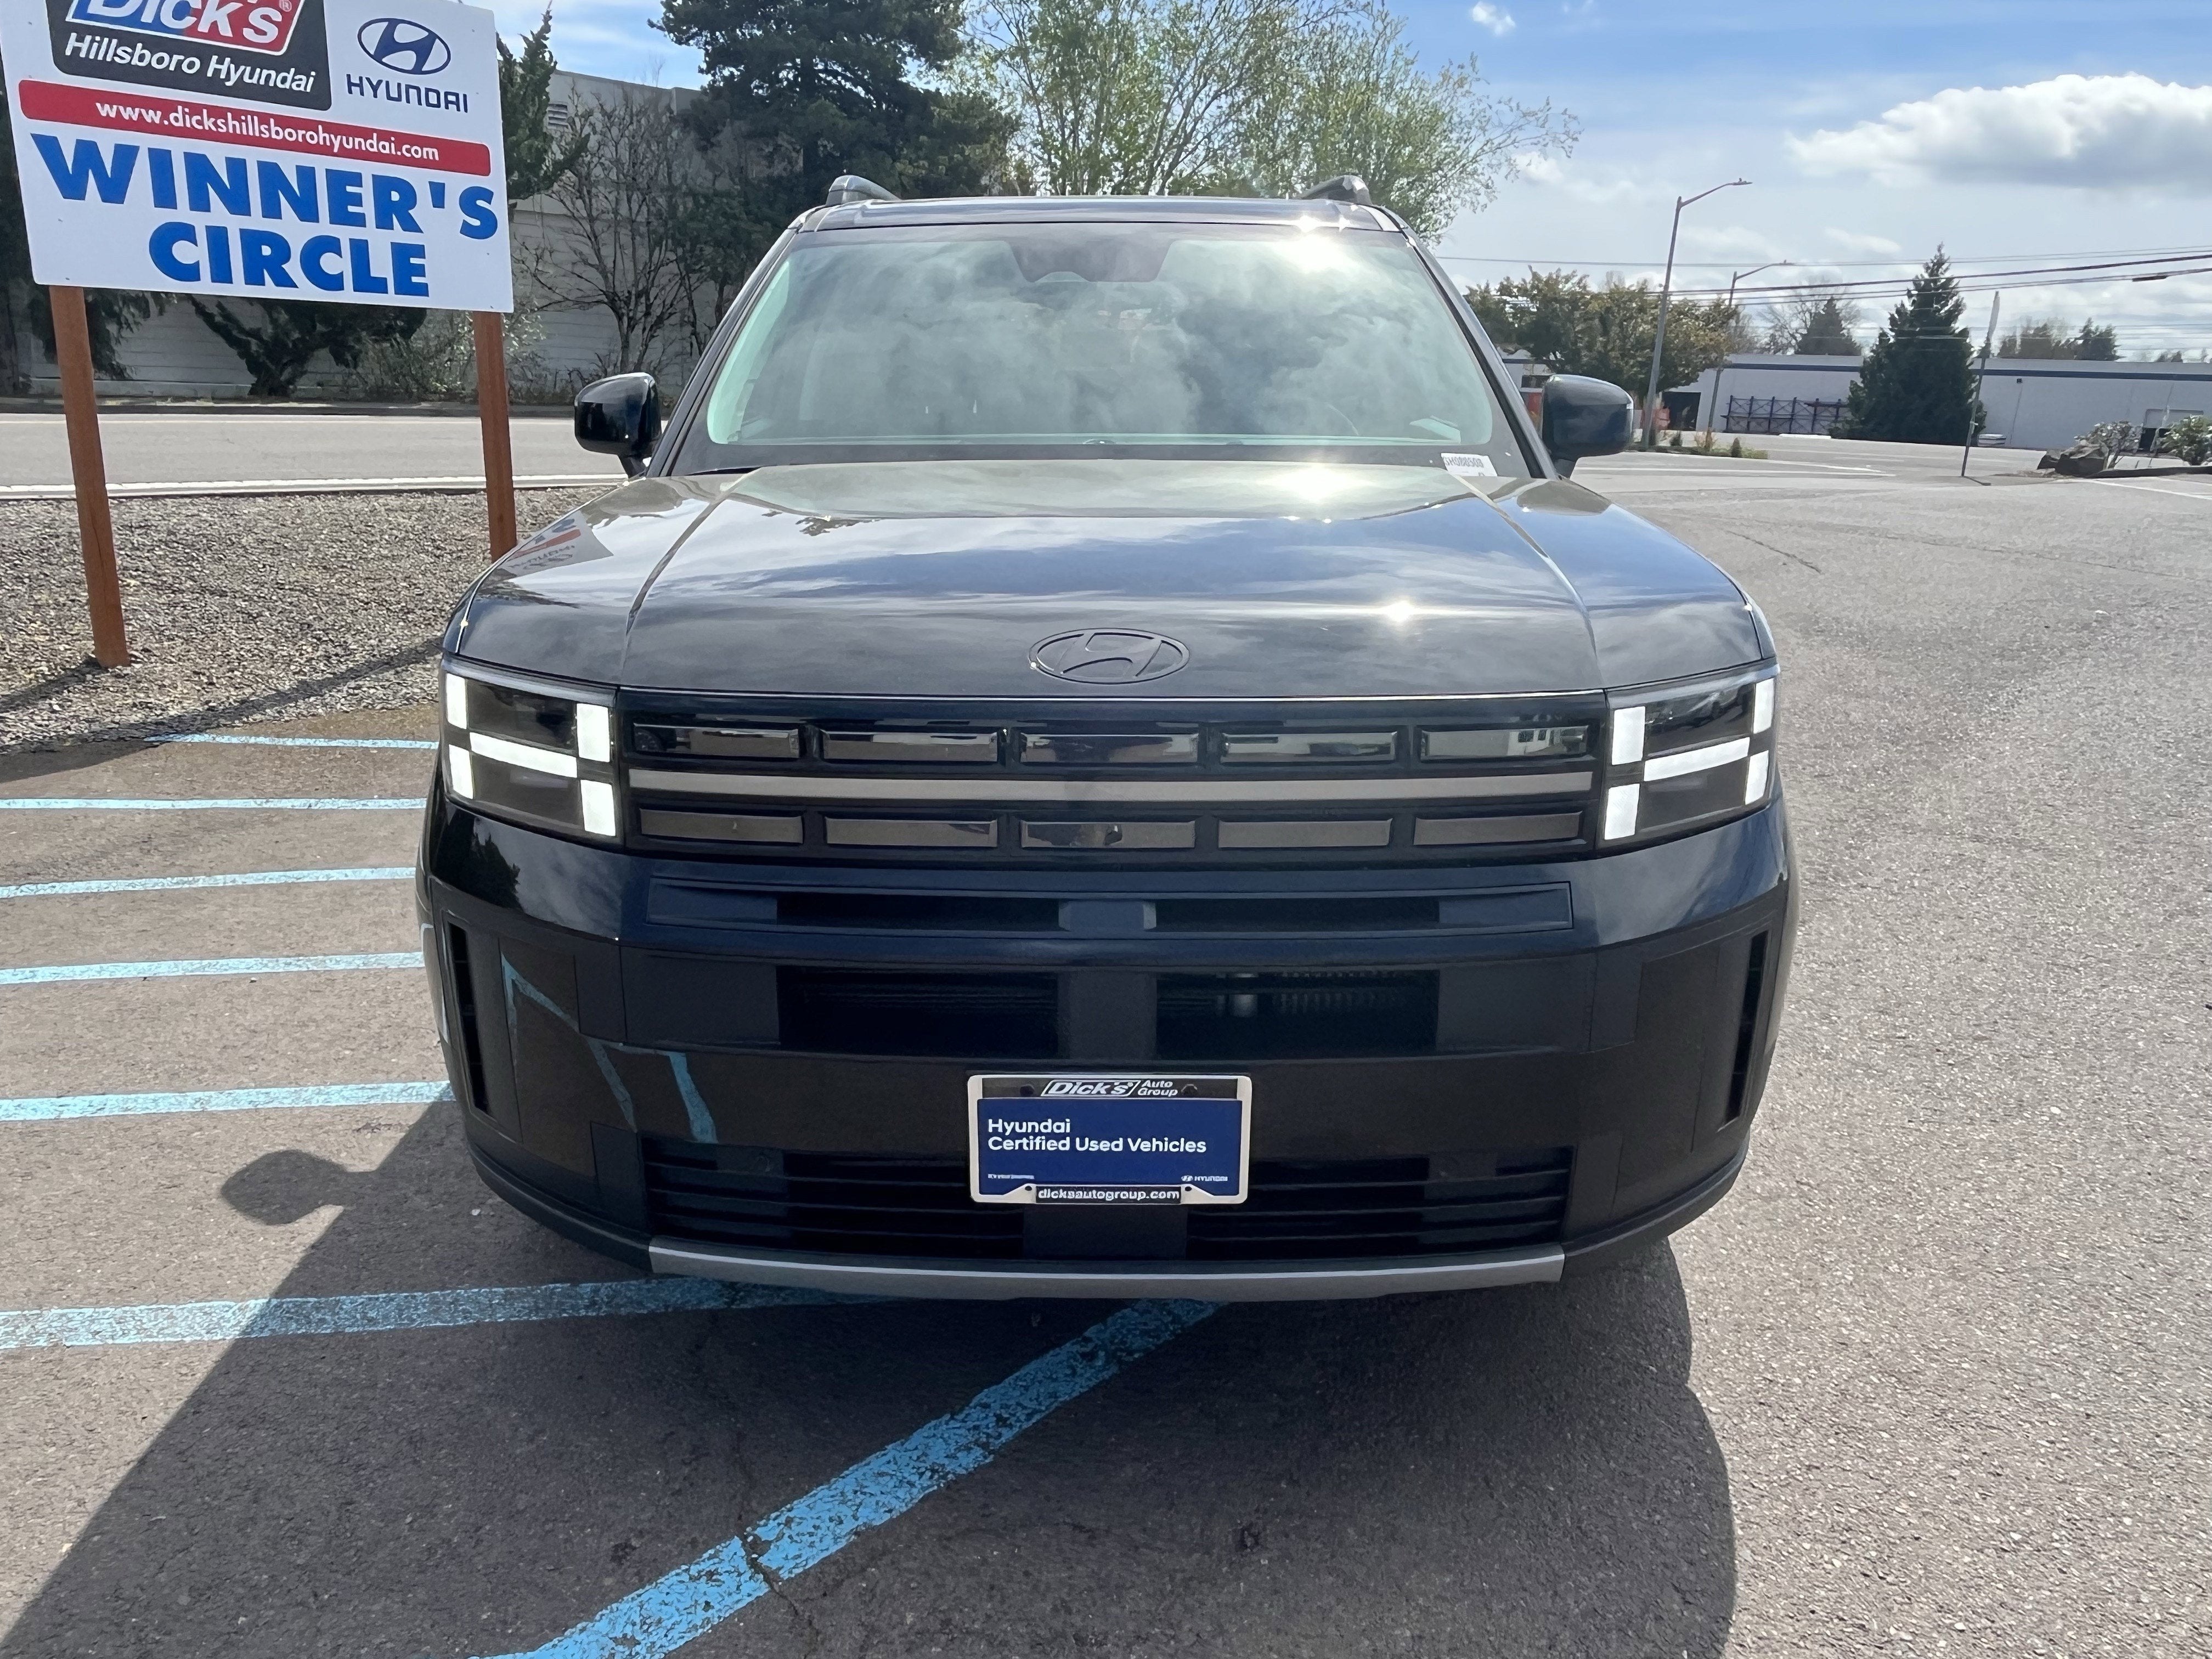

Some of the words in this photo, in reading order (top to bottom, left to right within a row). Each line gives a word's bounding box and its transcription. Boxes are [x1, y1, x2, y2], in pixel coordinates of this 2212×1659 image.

[65, 33, 200, 74] Hillsboro
[207, 55, 316, 92] Hyundai
[346, 74, 468, 113] HYUNDAI
[95, 100, 439, 161] www.dickshillsborohyundai.com
[31, 133, 498, 240] WINNER'S
[149, 222, 430, 297] CIRCLE
[1048, 1082, 1128, 1095] Dick's
[1137, 1088, 1178, 1097] Group
[988, 1119, 1071, 1135] Hyundai
[988, 1136, 1071, 1151] Certified
[1075, 1138, 1124, 1152] Used
[1127, 1138, 1207, 1153] Vehicles
